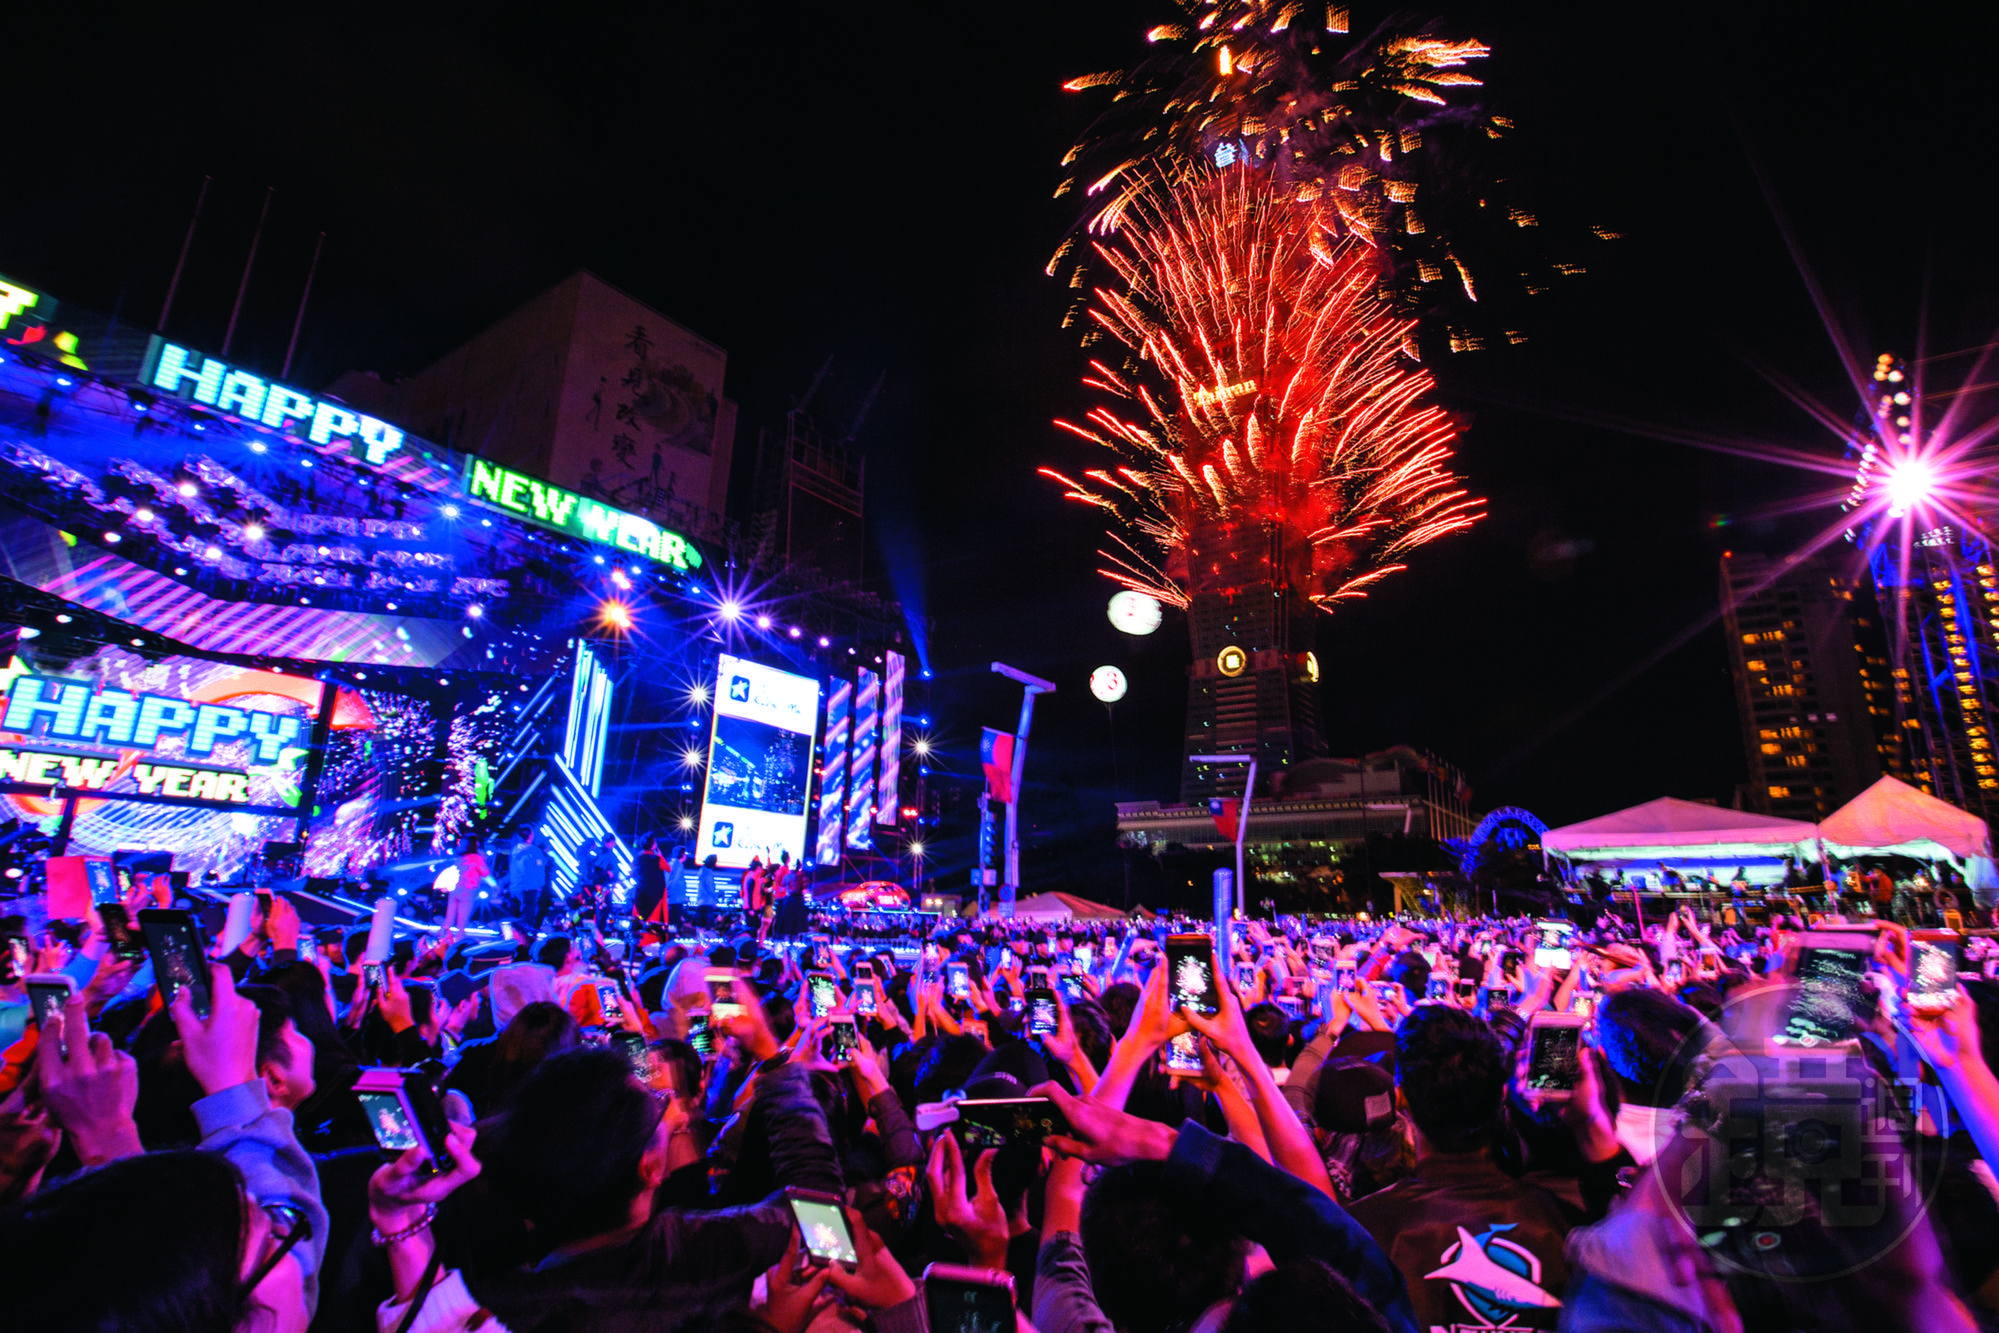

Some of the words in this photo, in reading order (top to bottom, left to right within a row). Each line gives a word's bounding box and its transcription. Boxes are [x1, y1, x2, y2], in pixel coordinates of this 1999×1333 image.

[154, 343, 403, 465] HAPPY
[470, 459, 578, 526] NEW
[587, 504, 689, 570] YEAR
[3, 677, 301, 760] HAPPY
[0, 751, 119, 789] NEW
[132, 763, 250, 802] YEAR
